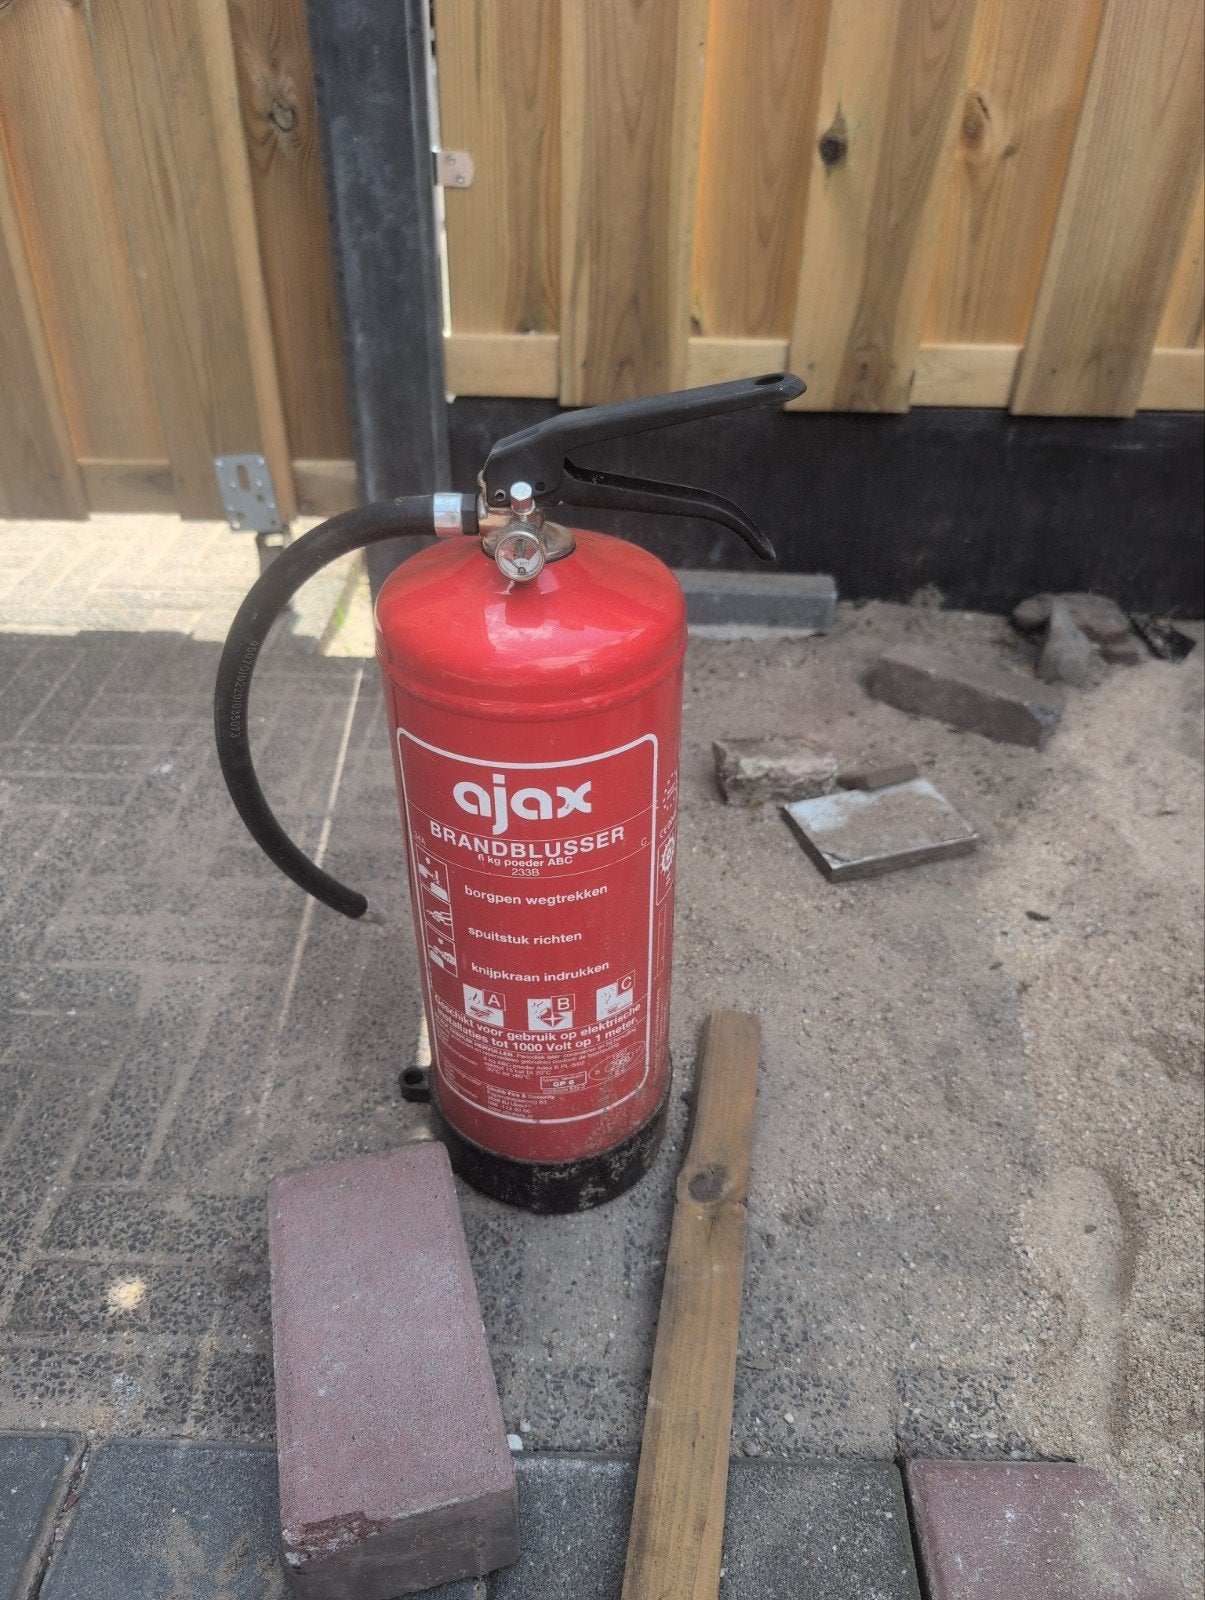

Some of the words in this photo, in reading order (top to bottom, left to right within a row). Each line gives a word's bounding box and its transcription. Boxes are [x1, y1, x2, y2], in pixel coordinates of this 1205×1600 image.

[453, 774, 592, 835] ajax
[429, 820, 625, 858] BRANDBLUSSER
[477, 853, 485, 862] 6
[487, 855, 501, 867] kg
[504, 858, 544, 870] poeder
[547, 856, 573, 867] ABC
[511, 868, 540, 877] 233B
[464, 885, 522, 907] borgpen
[525, 884, 608, 907] wegtrekken
[468, 926, 530, 945] spuitstuk
[533, 931, 582, 945] richten
[471, 962, 540, 983] knijpkraan
[544, 961, 610, 982] indrukken
[620, 976, 633, 990] C
[487, 994, 501, 1008] A
[557, 997, 570, 1011] B
[476, 1023, 503, 1037] voor
[507, 1031, 556, 1043] gebruik
[560, 1031, 577, 1043] op
[580, 1003, 641, 1036] elektrische
[491, 1037, 509, 1049] tot
[513, 1042, 543, 1052] 1000
[546, 1041, 572, 1051] Volt
[575, 1039, 591, 1051] op
[604, 1018, 638, 1039] meter.
